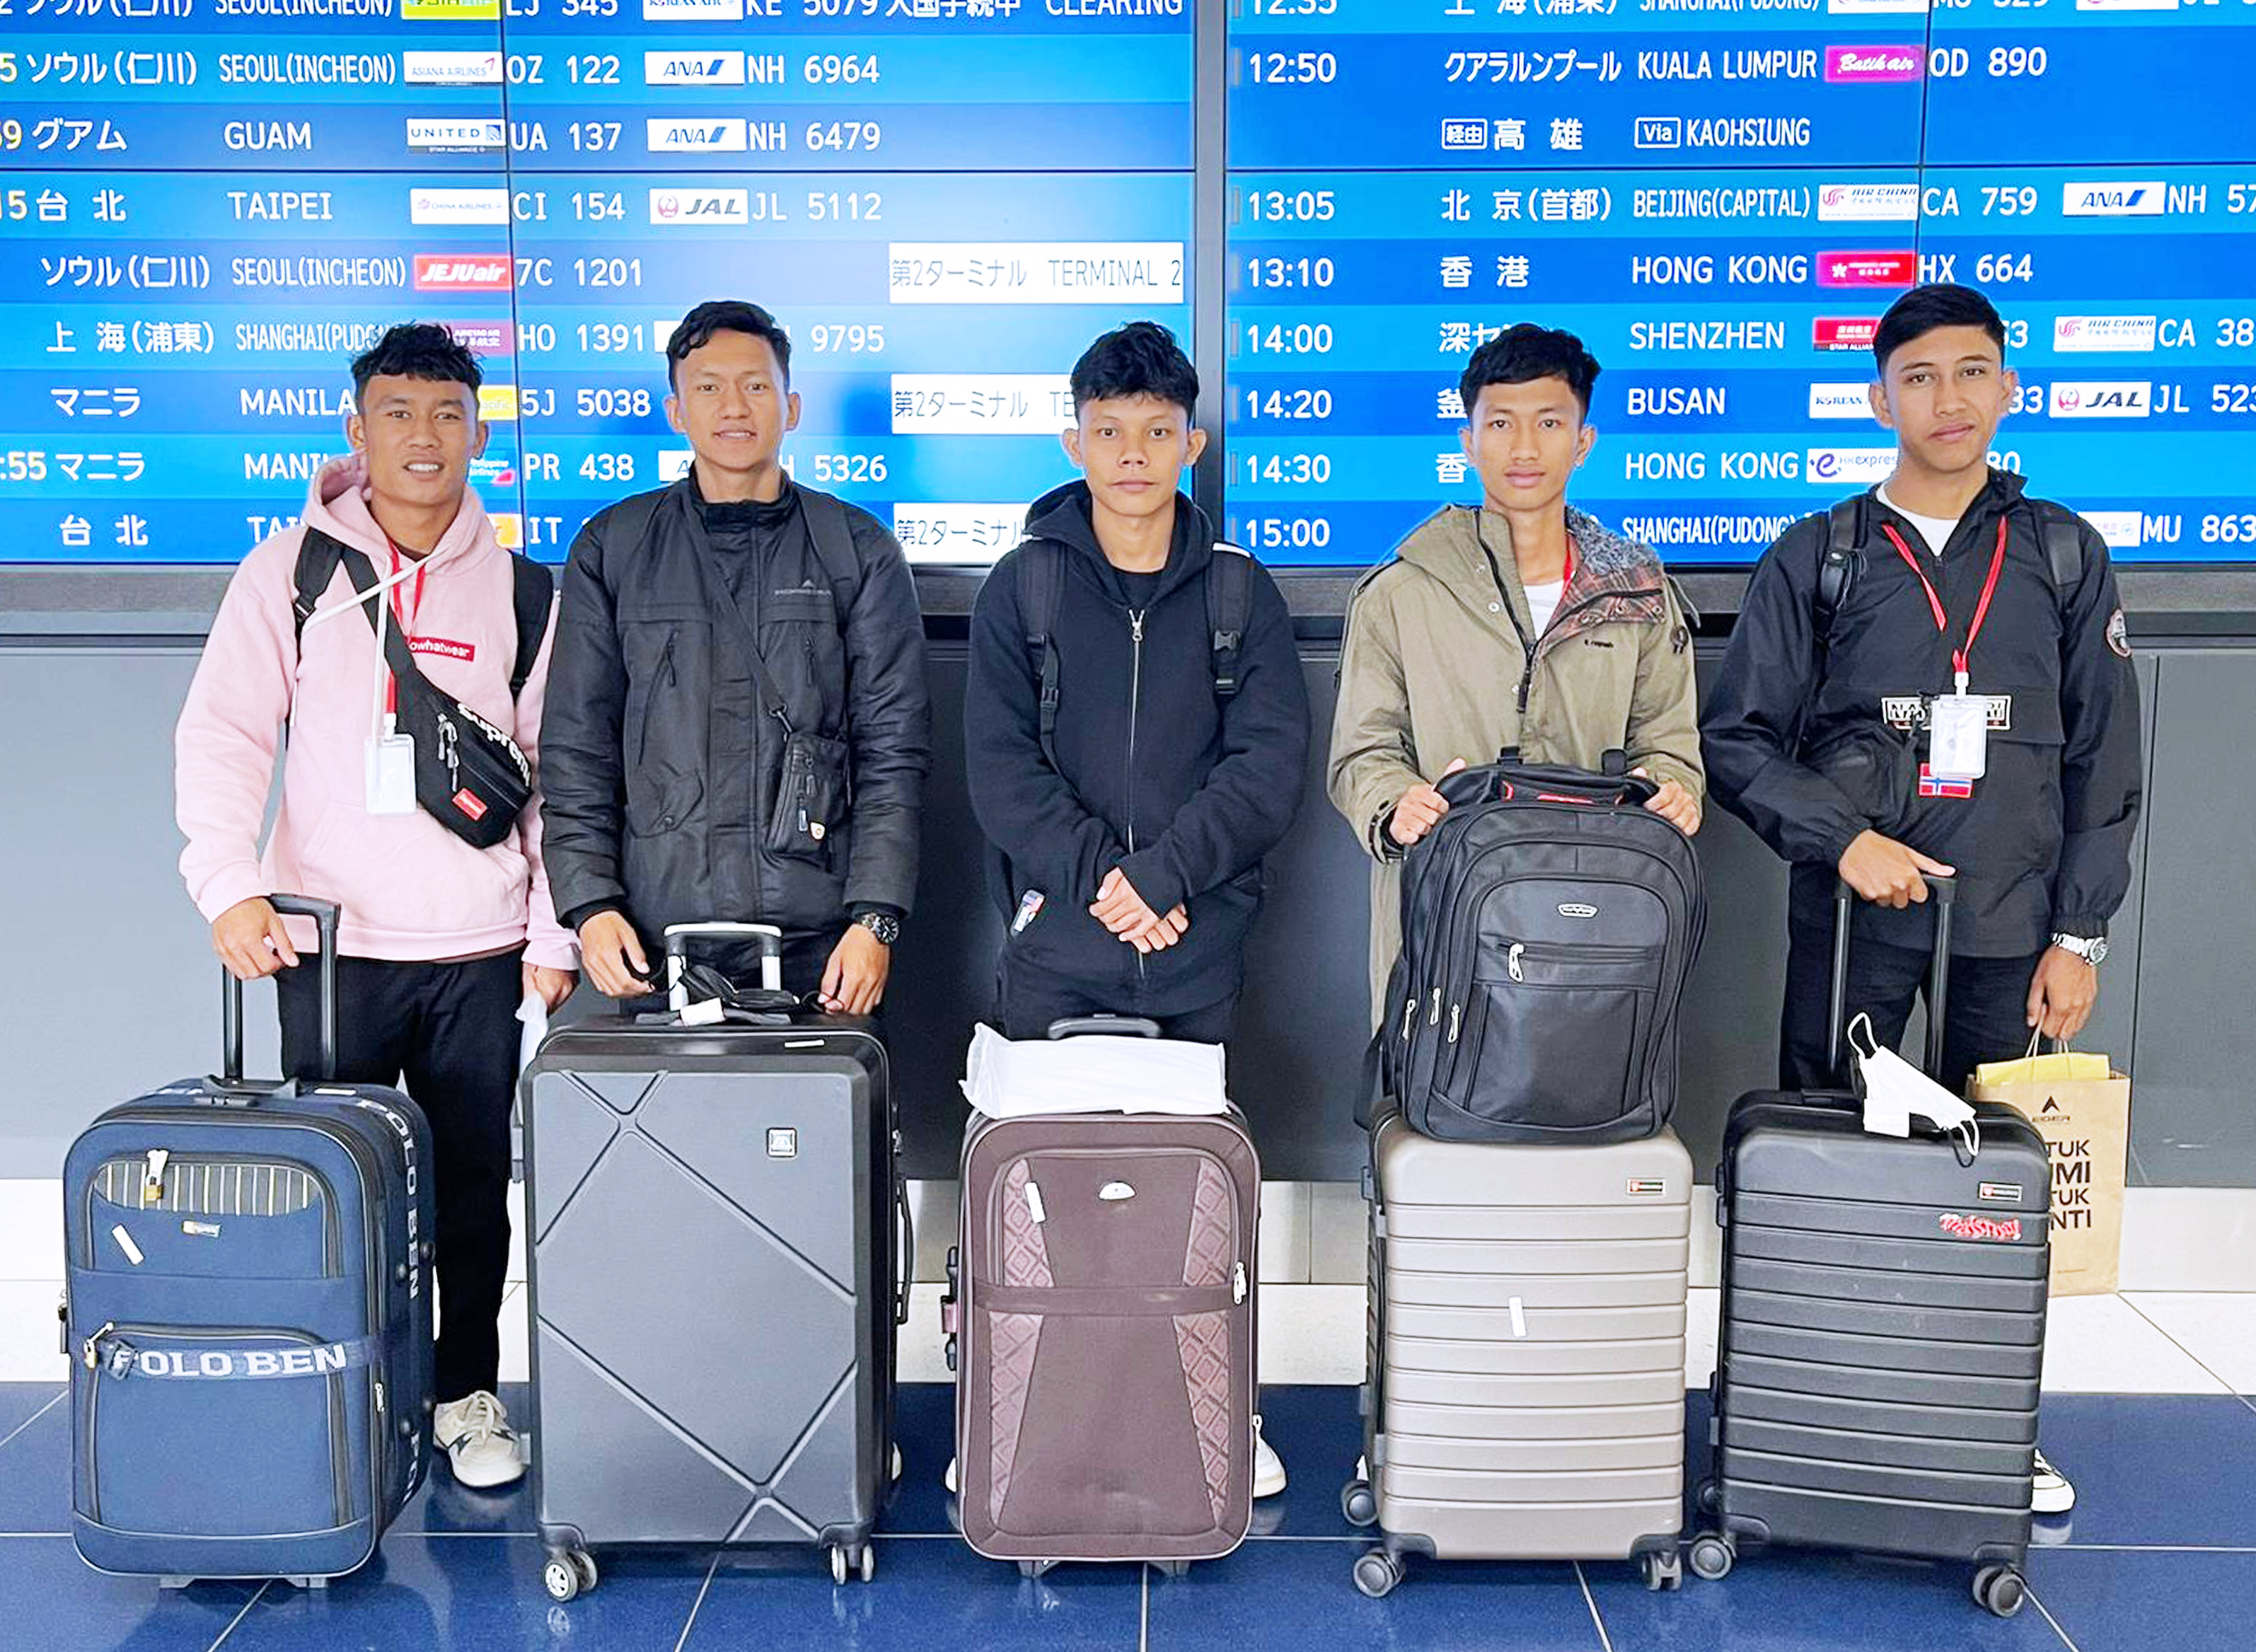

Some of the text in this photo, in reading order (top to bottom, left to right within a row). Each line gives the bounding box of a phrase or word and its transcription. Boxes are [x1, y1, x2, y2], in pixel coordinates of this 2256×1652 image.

[27, 52, 196, 85] ソウル(仁川)
[219, 54, 395, 84] SEOUL(INCHEON)
[507, 55, 620, 83] OZ 122
[662, 59, 705, 77] ANA
[748, 55, 879, 83] NH 6964
[1251, 53, 1336, 82] 12:50
[1445, 49, 1621, 82] クアラルンプール
[1638, 50, 1817, 79] KUALA LUMPUR
[1928, 47, 2047, 76] OD 890
[33, 118, 127, 150] グアム
[225, 122, 311, 149] GUAM
[411, 129, 480, 137] UNITED
[510, 123, 621, 151] UA 137
[664, 127, 706, 144] ANA
[750, 122, 880, 150] NH 6479
[1446, 125, 1483, 145] 経由
[1641, 118, 1810, 146] Via KAOHSIUNG
[228, 192, 332, 219] TAIPEI
[512, 192, 625, 220] CI 154
[686, 199, 741, 215] JAL
[753, 193, 881, 220] JL 5112
[1249, 192, 1334, 220] 13:05
[1634, 187, 1810, 218] BEIJING(CAPITAL)
[1921, 187, 2037, 216] CA 759
[2080, 192, 2124, 208] ANA
[2168, 185, 2206, 213] NH
[42, 255, 209, 288] ソウル(仁川)
[232, 257, 405, 287] SEOUL(INCHEON)
[515, 258, 640, 288] 7C 1201
[891, 259, 1026, 287] 第2ターミナル
[1048, 260, 1181, 286] TERMINAL 2
[1249, 258, 1334, 287] 13:10
[1633, 255, 1807, 283] HONG KONG
[1918, 254, 1955, 283] HX
[1977, 254, 2032, 282] 664
[518, 324, 555, 351] HO
[577, 324, 642, 352] 1391
[811, 325, 884, 352] 9795
[1248, 324, 1332, 352] 14:00
[1439, 323, 1512, 353] 深セ
[1630, 322, 1784, 350] SHENZHEN
[2159, 319, 2195, 347] CA
[51, 388, 140, 417] マニラ
[241, 388, 357, 415] MANILA
[521, 389, 650, 416] 5J 5038
[895, 391, 1027, 417] 第2ターミナル
[1248, 390, 1331, 418] 14:20
[1629, 388, 1725, 415] BUSAN
[2086, 392, 2142, 408] JAL
[2154, 386, 2189, 412] JL
[56, 452, 144, 480] マニラ
[523, 454, 634, 483] PR 438
[813, 454, 886, 483] 5326
[1247, 454, 1330, 483] 14:30
[1626, 452, 1798, 479] HONG KONG
[529, 517, 562, 543] IT
[1246, 519, 1329, 546] 15:00
[2141, 513, 2181, 542] MU
[248, 1344, 347, 1376] BEN
